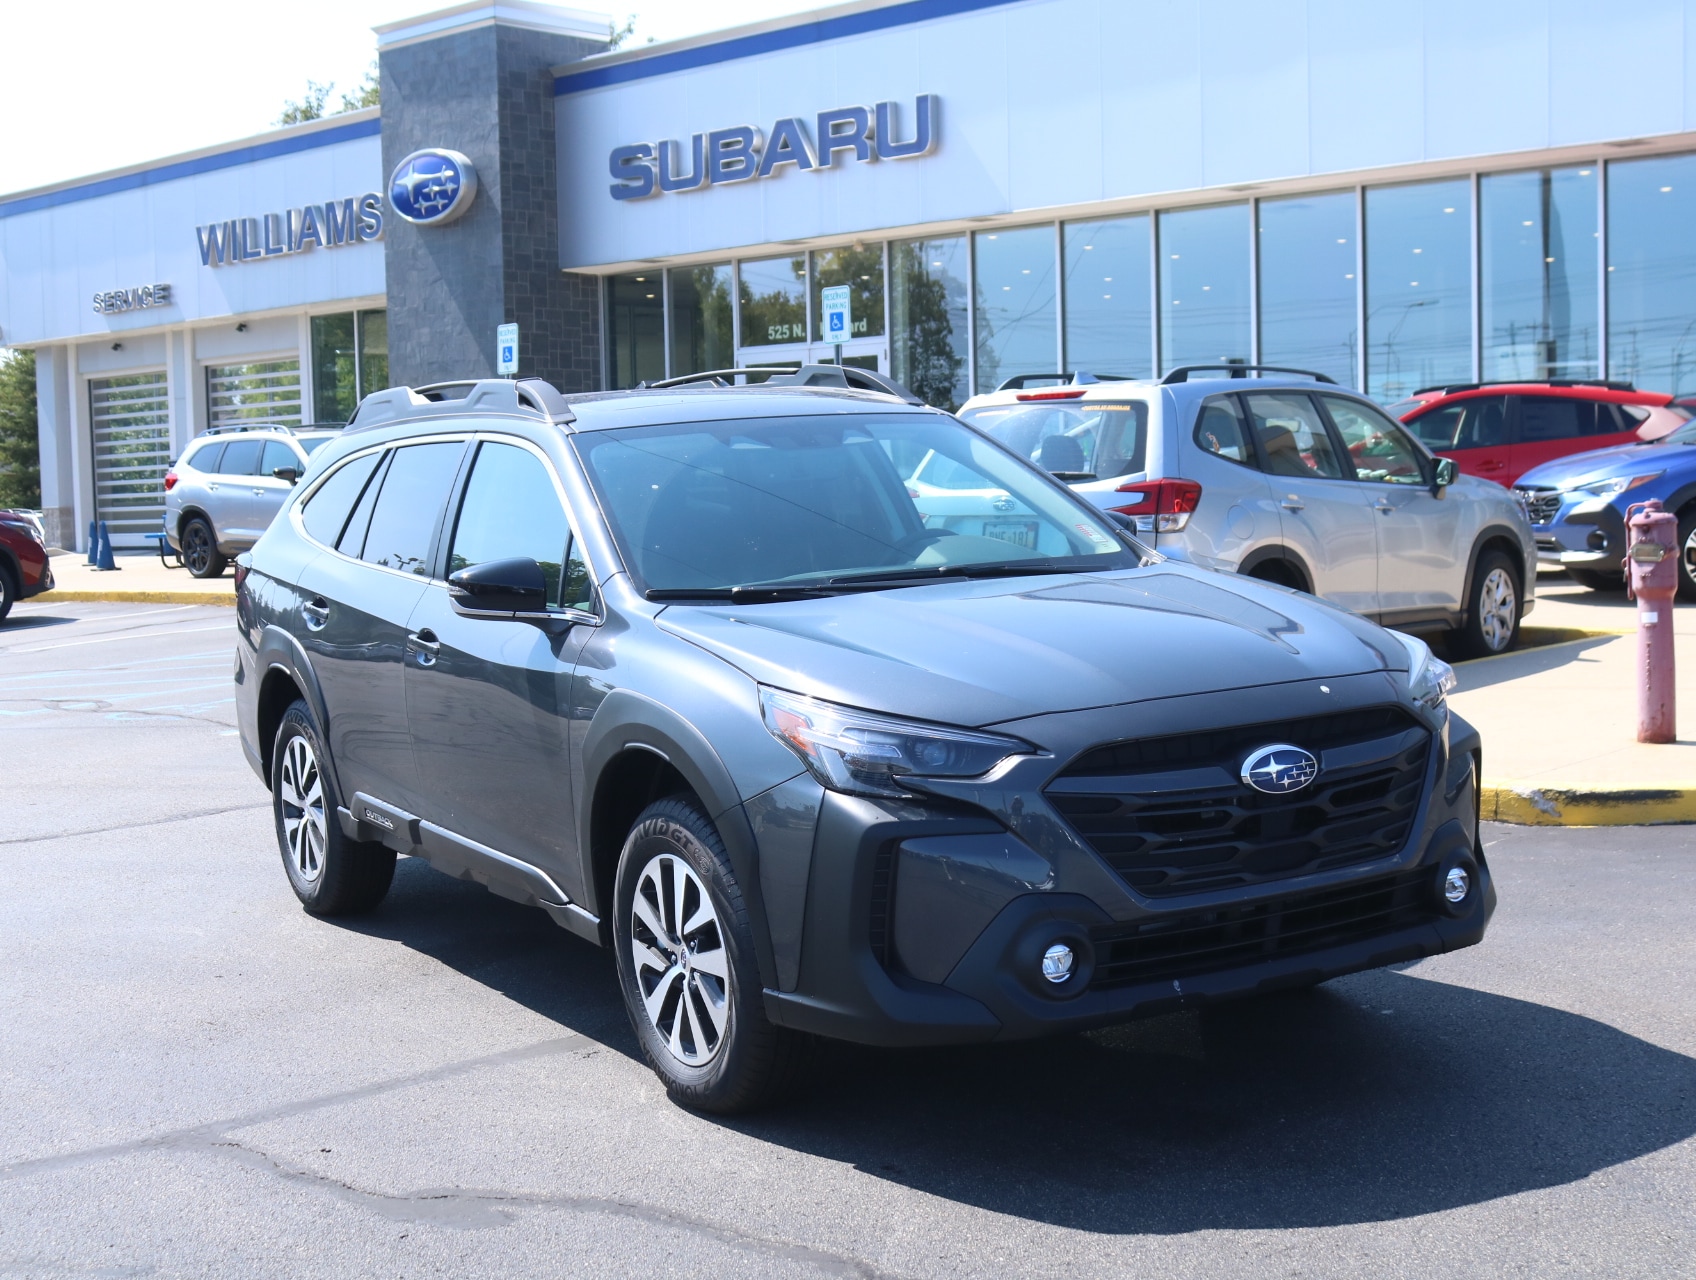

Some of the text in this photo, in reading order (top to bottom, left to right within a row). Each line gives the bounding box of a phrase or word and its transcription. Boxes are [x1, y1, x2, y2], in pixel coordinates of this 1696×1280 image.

[609, 94, 941, 201] SUBARU
[196, 192, 384, 266] WILLIAMS
[93, 283, 171, 314] SERVICE
[768, 325, 789, 339] 525
[793, 324, 806, 337] N.
[365, 808, 394, 828] OUTBACK
[671, 828, 693, 850] GT
